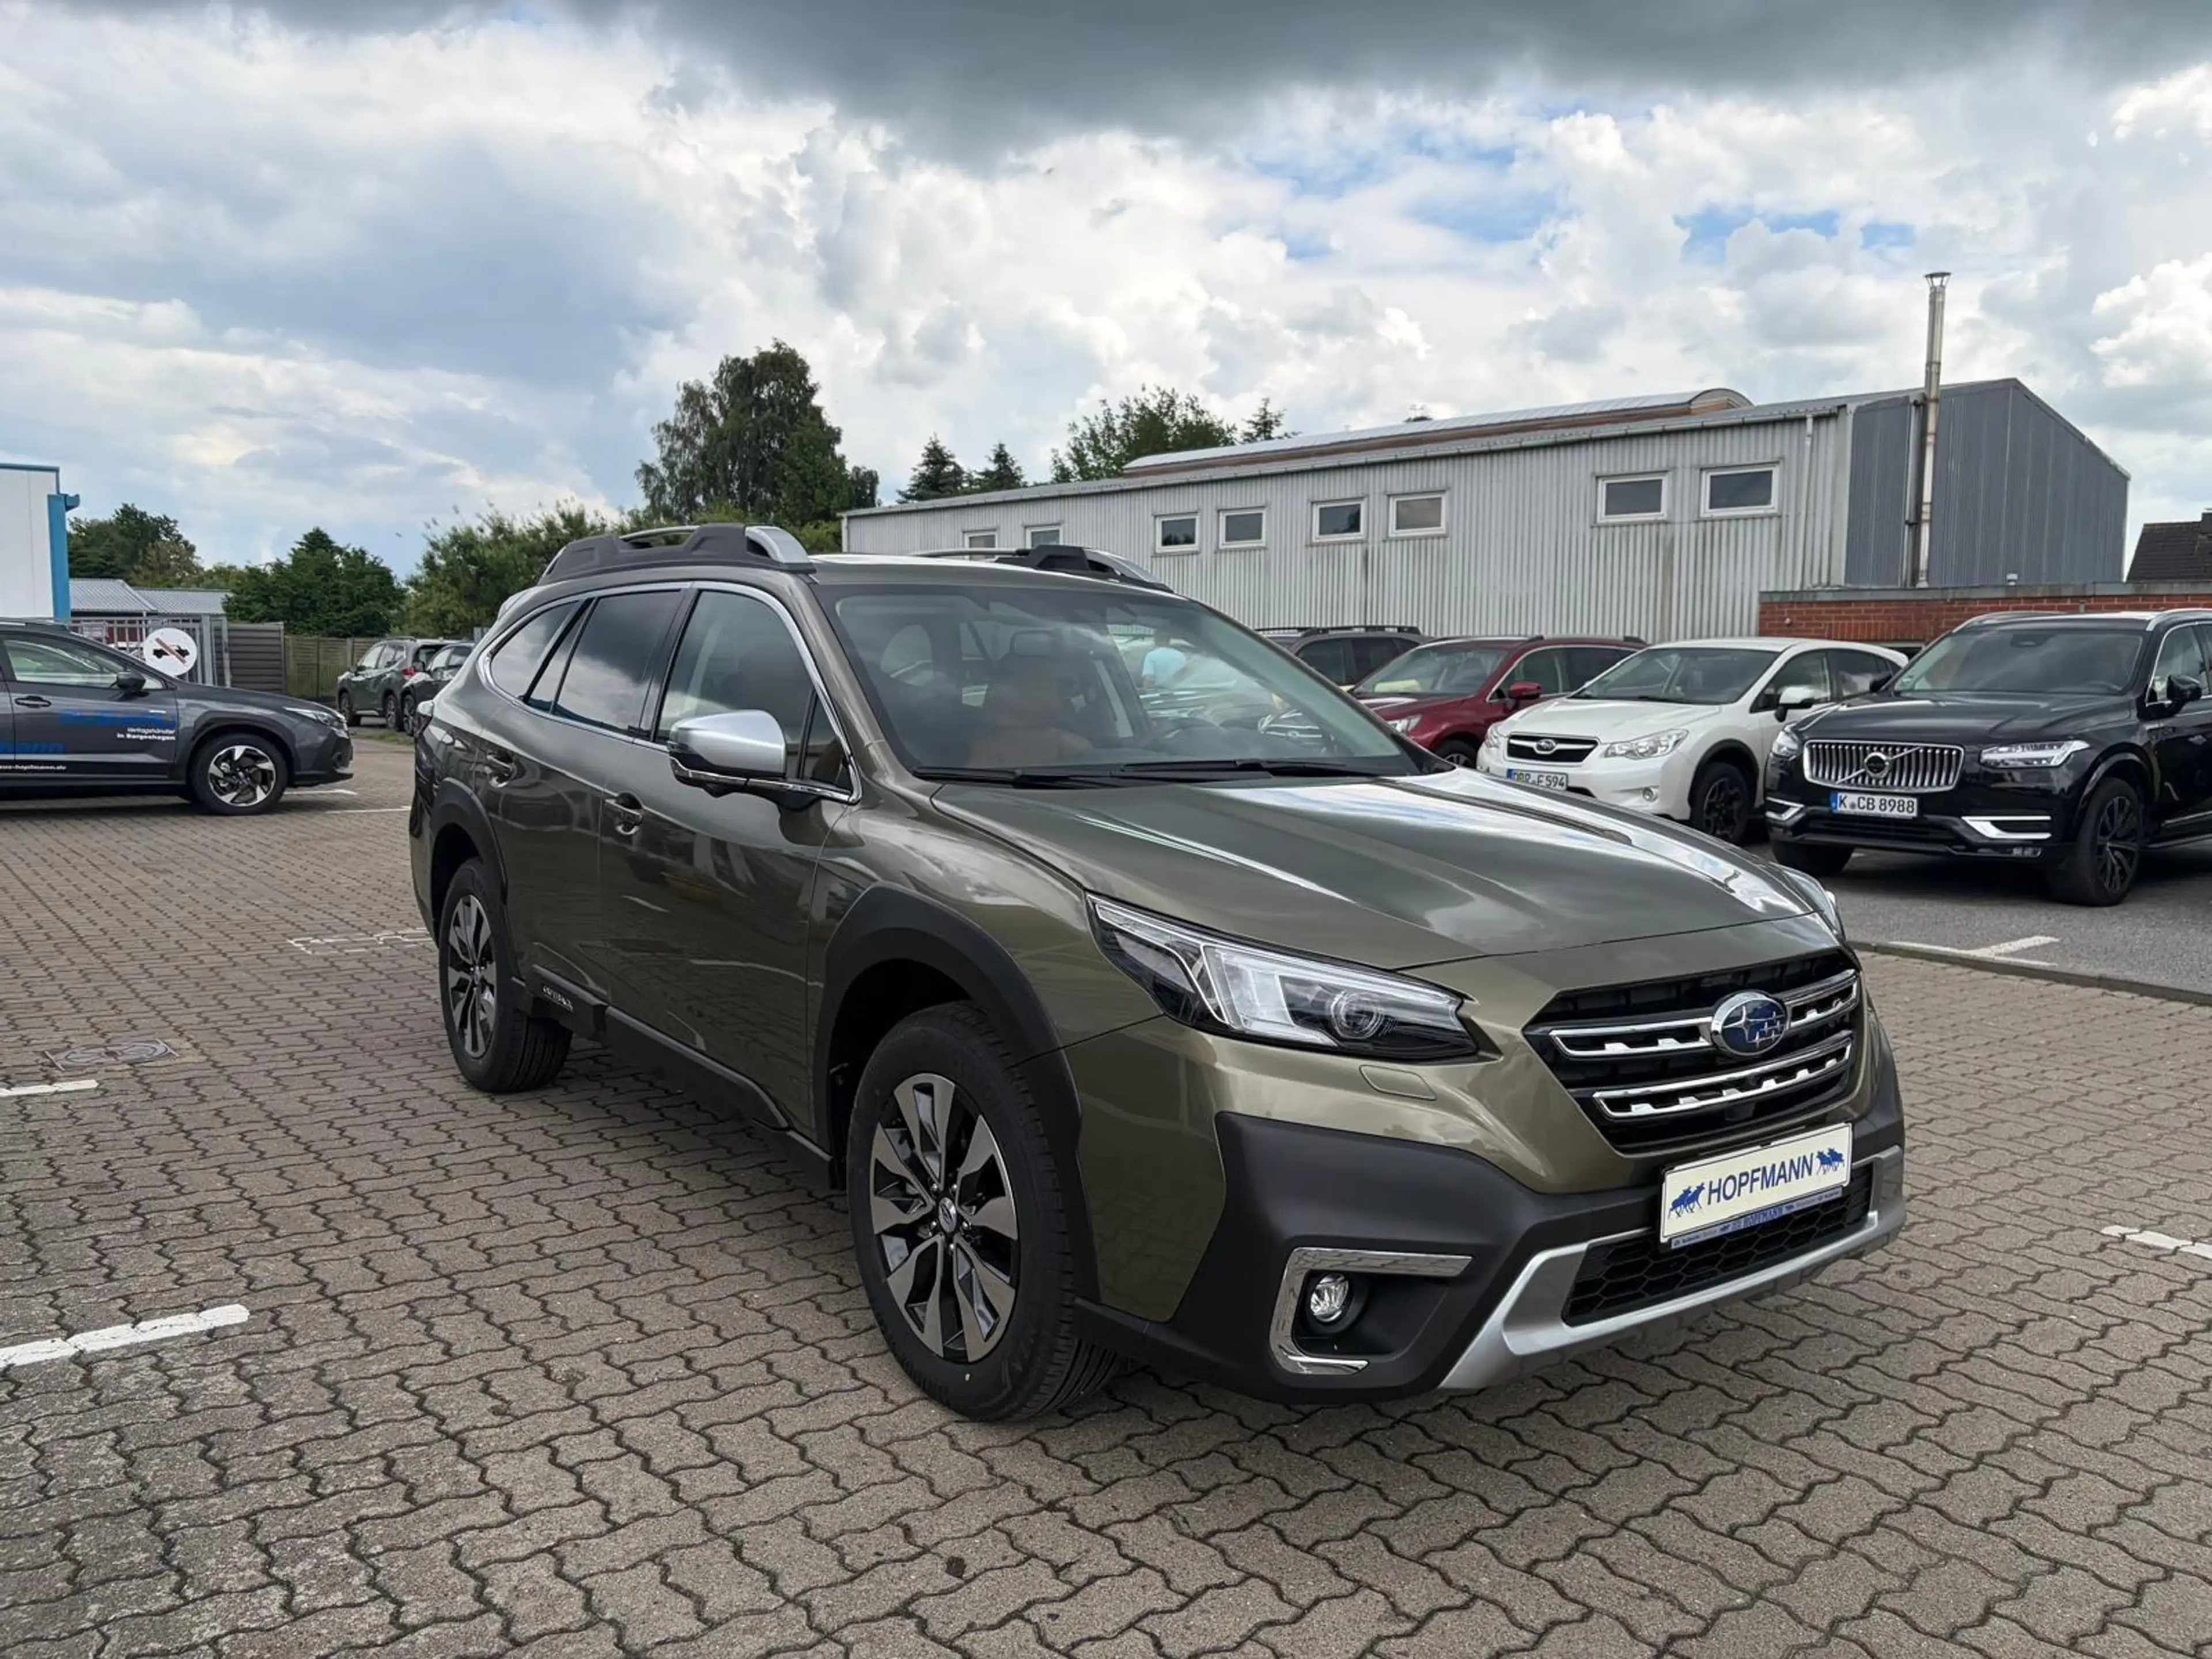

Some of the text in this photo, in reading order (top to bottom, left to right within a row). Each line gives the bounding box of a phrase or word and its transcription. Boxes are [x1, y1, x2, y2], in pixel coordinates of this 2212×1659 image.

[1546, 775, 1564, 787] 594
[1839, 795, 1914, 813] K CB 8988
[1707, 1153, 1814, 1206] HOPFMANN
